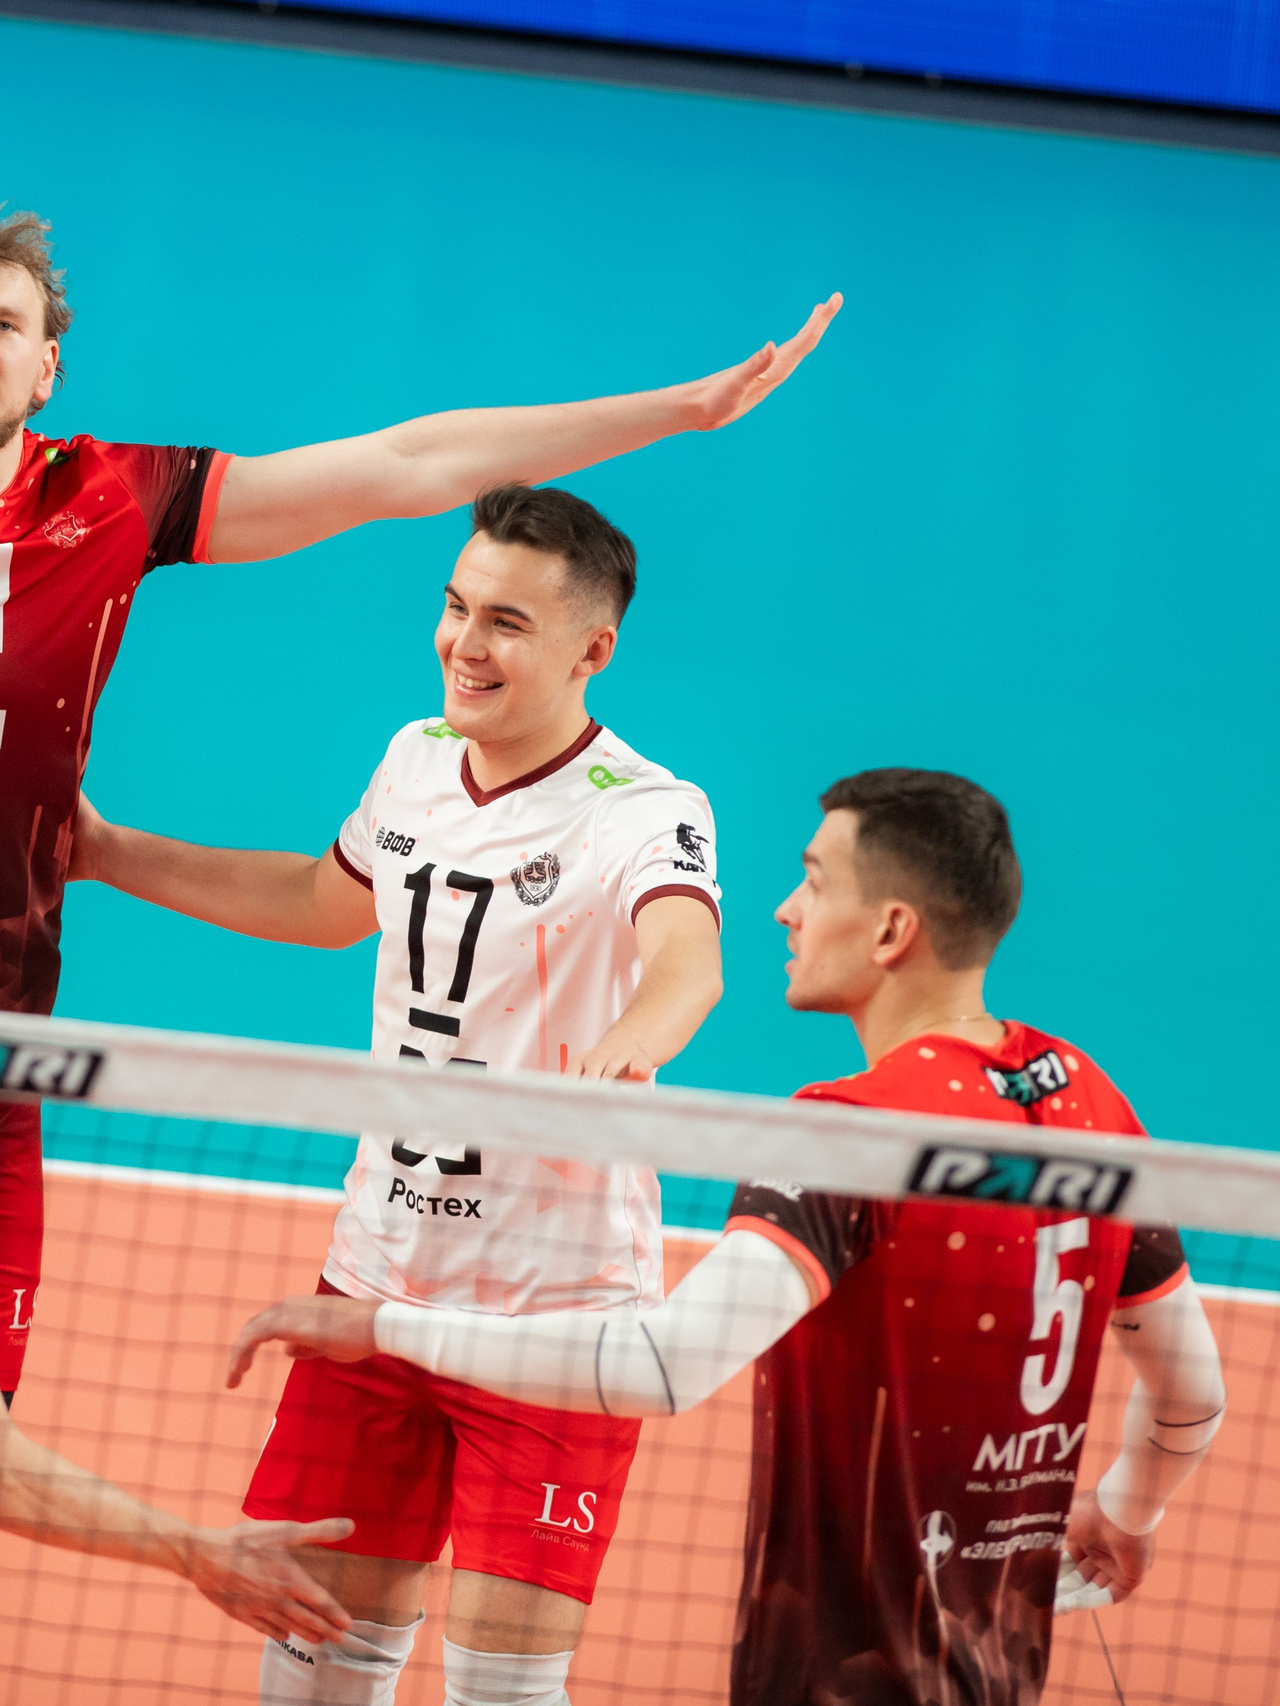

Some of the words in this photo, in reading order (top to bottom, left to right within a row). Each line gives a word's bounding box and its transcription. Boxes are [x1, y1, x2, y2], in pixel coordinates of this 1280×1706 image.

[381, 831, 416, 857] ВФВ
[404, 862, 494, 1003] 17
[387, 1177, 482, 1219] Ростех
[920, 1151, 1120, 1212] PARI
[9, 1287, 39, 1329] L
[1020, 1217, 1090, 1416] 5
[972, 1422, 1087, 1472] МГТУ
[534, 1482, 597, 1533] LS
[530, 1529, 560, 1543] Лайв
